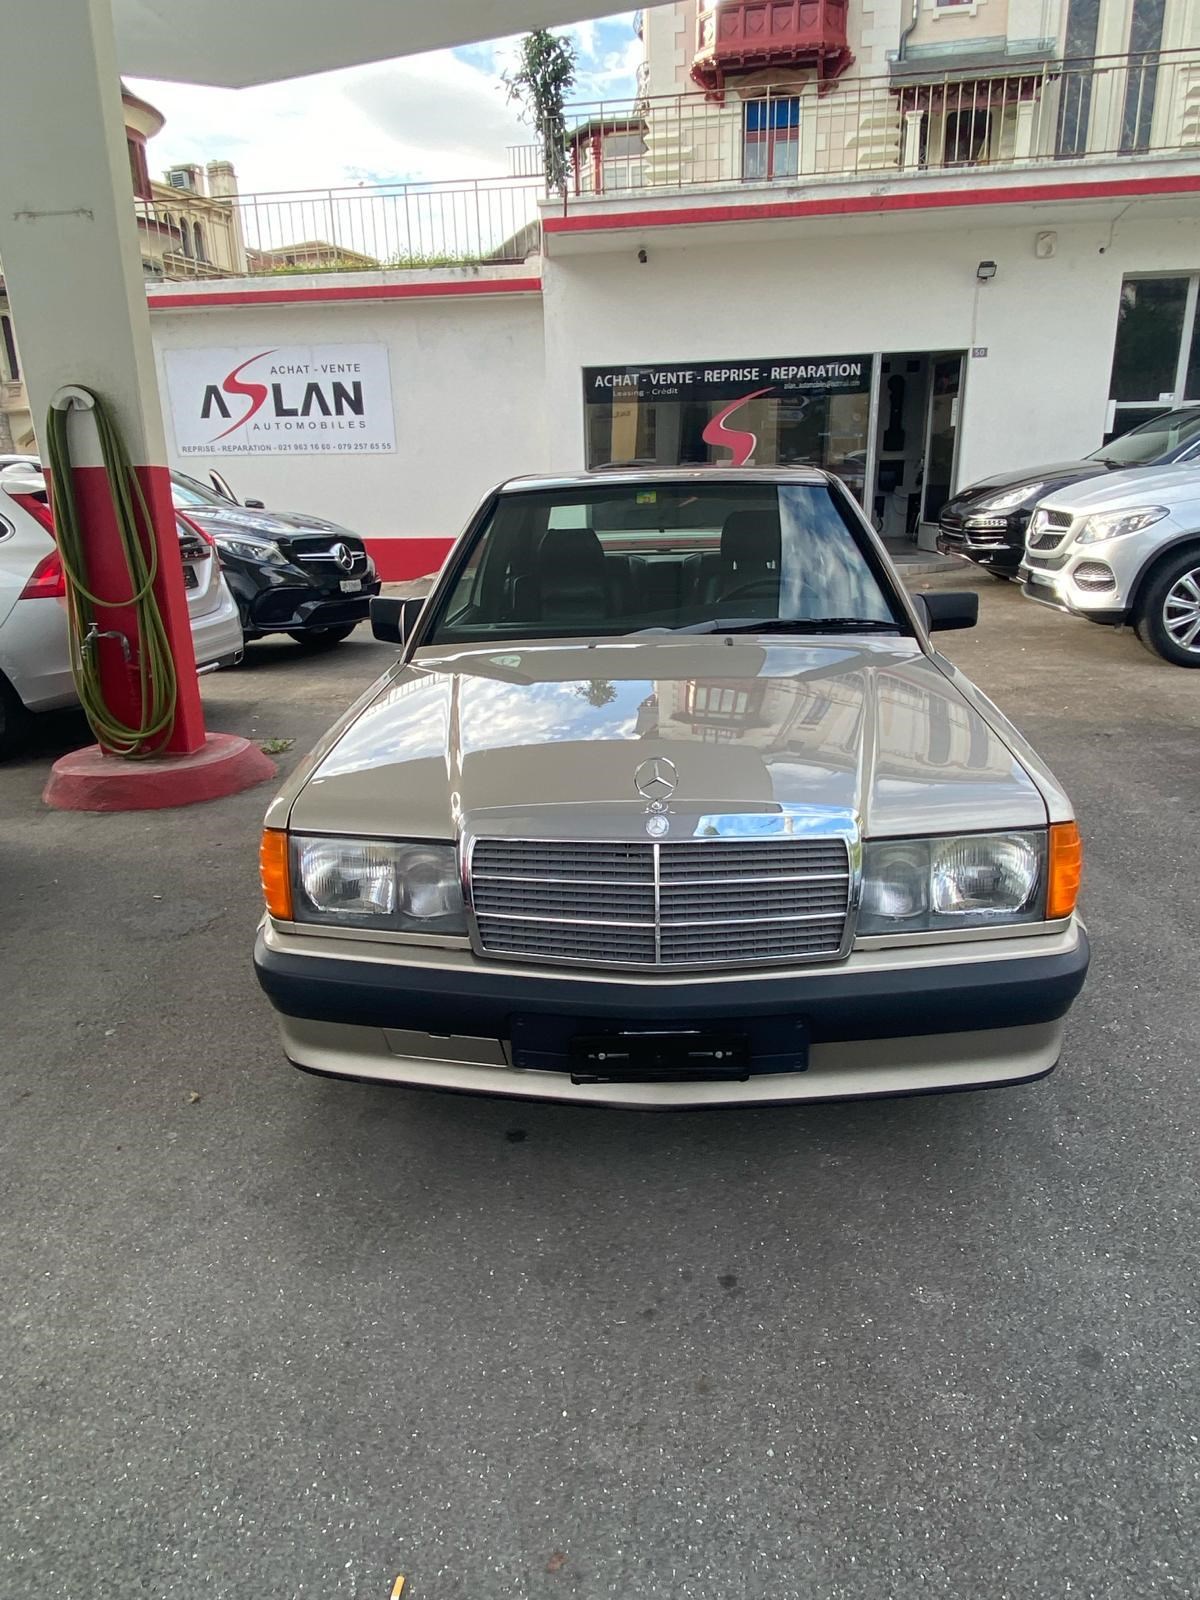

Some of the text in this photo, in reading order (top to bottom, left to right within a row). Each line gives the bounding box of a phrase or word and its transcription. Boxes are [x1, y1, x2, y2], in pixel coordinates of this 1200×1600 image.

[975, 348, 985, 356] 50
[270, 365, 309, 375] ACHAT
[321, 363, 361, 374] VENTE
[595, 373, 639, 388] ACHAT
[650, 371, 694, 385] VENTE
[704, 367, 760, 382] REPRISE
[770, 363, 861, 380] REPARATION
[200, 348, 365, 444] ASLAN
[253, 420, 366, 431] AUTOMOBILES
[182, 445, 216, 453] REPRISE
[222, 444, 272, 452] REPARATION
[278, 443, 291, 451] 021
[337, 442, 352, 450] 079
[353, 442, 368, 450] 257
[370, 442, 380, 450] 65
[382, 442, 392, 450] 55
